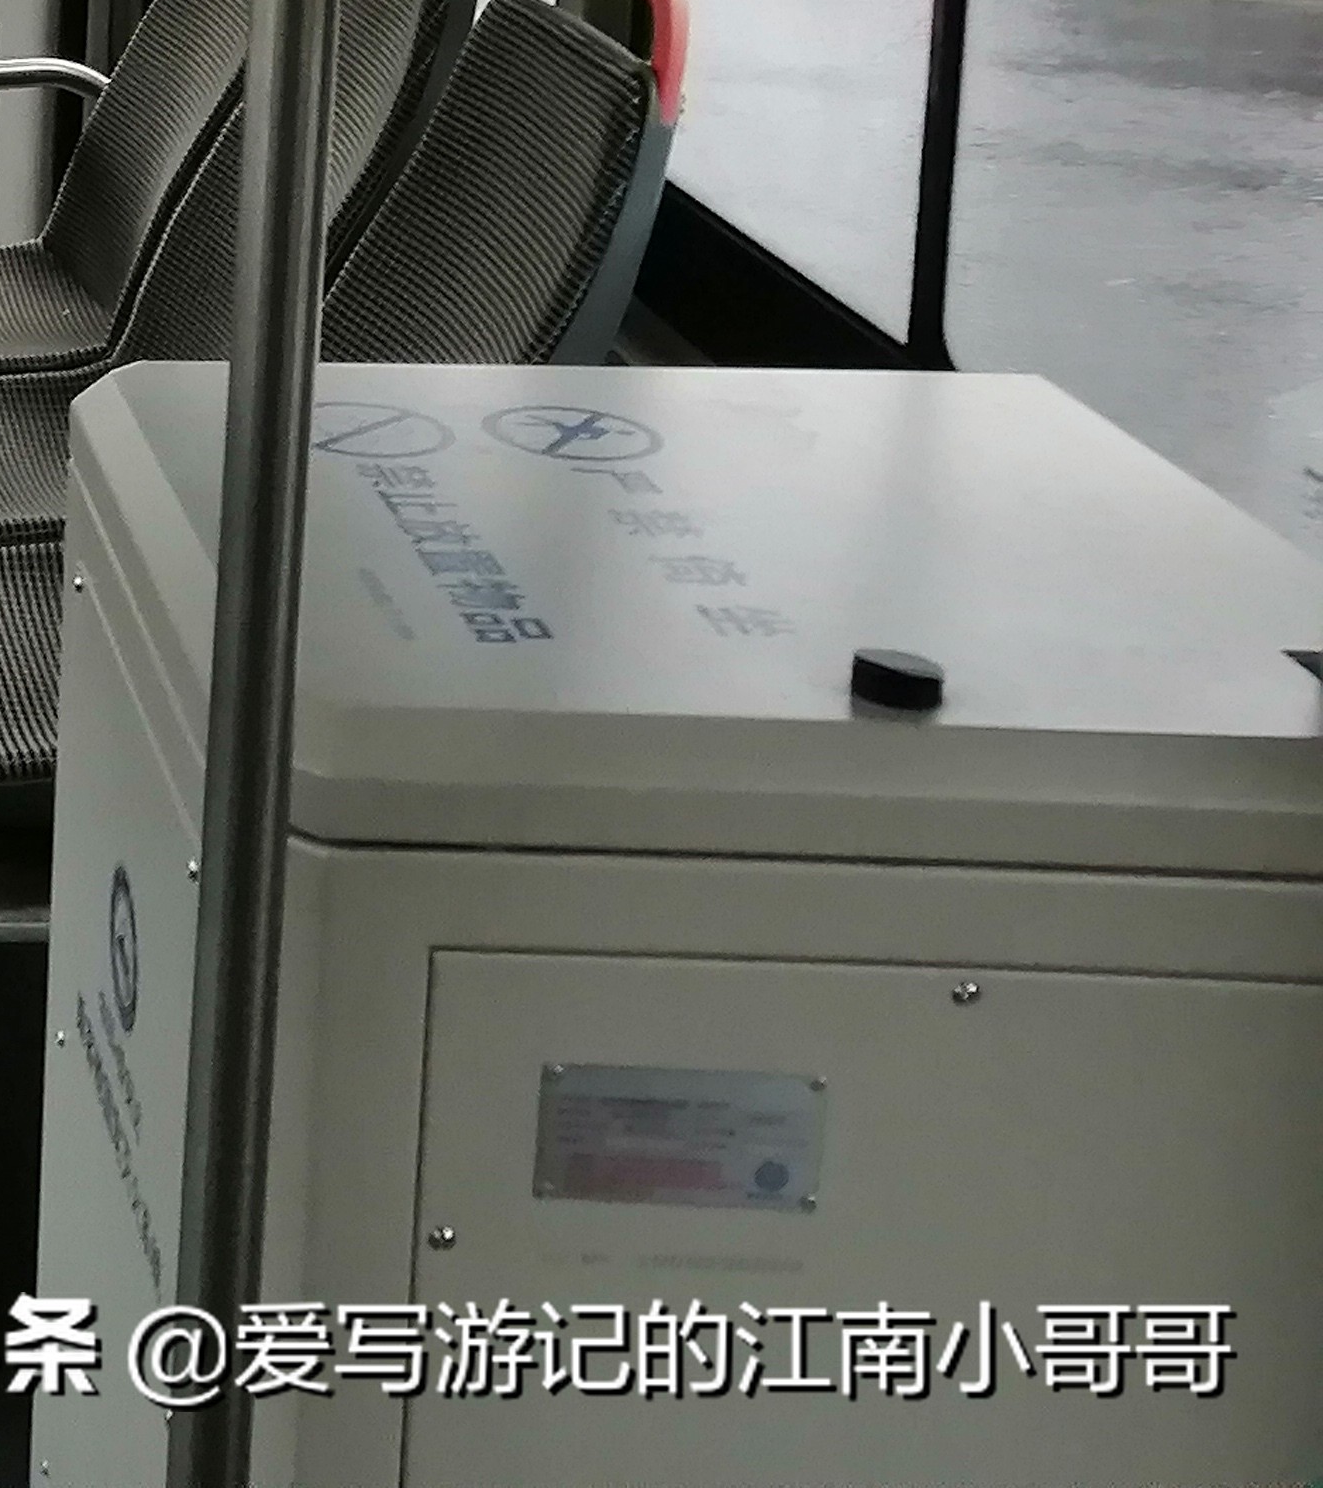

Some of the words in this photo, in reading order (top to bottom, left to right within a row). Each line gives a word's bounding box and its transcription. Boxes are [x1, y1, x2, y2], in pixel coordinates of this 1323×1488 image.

[356, 462, 554, 644] 禁止放置物品
